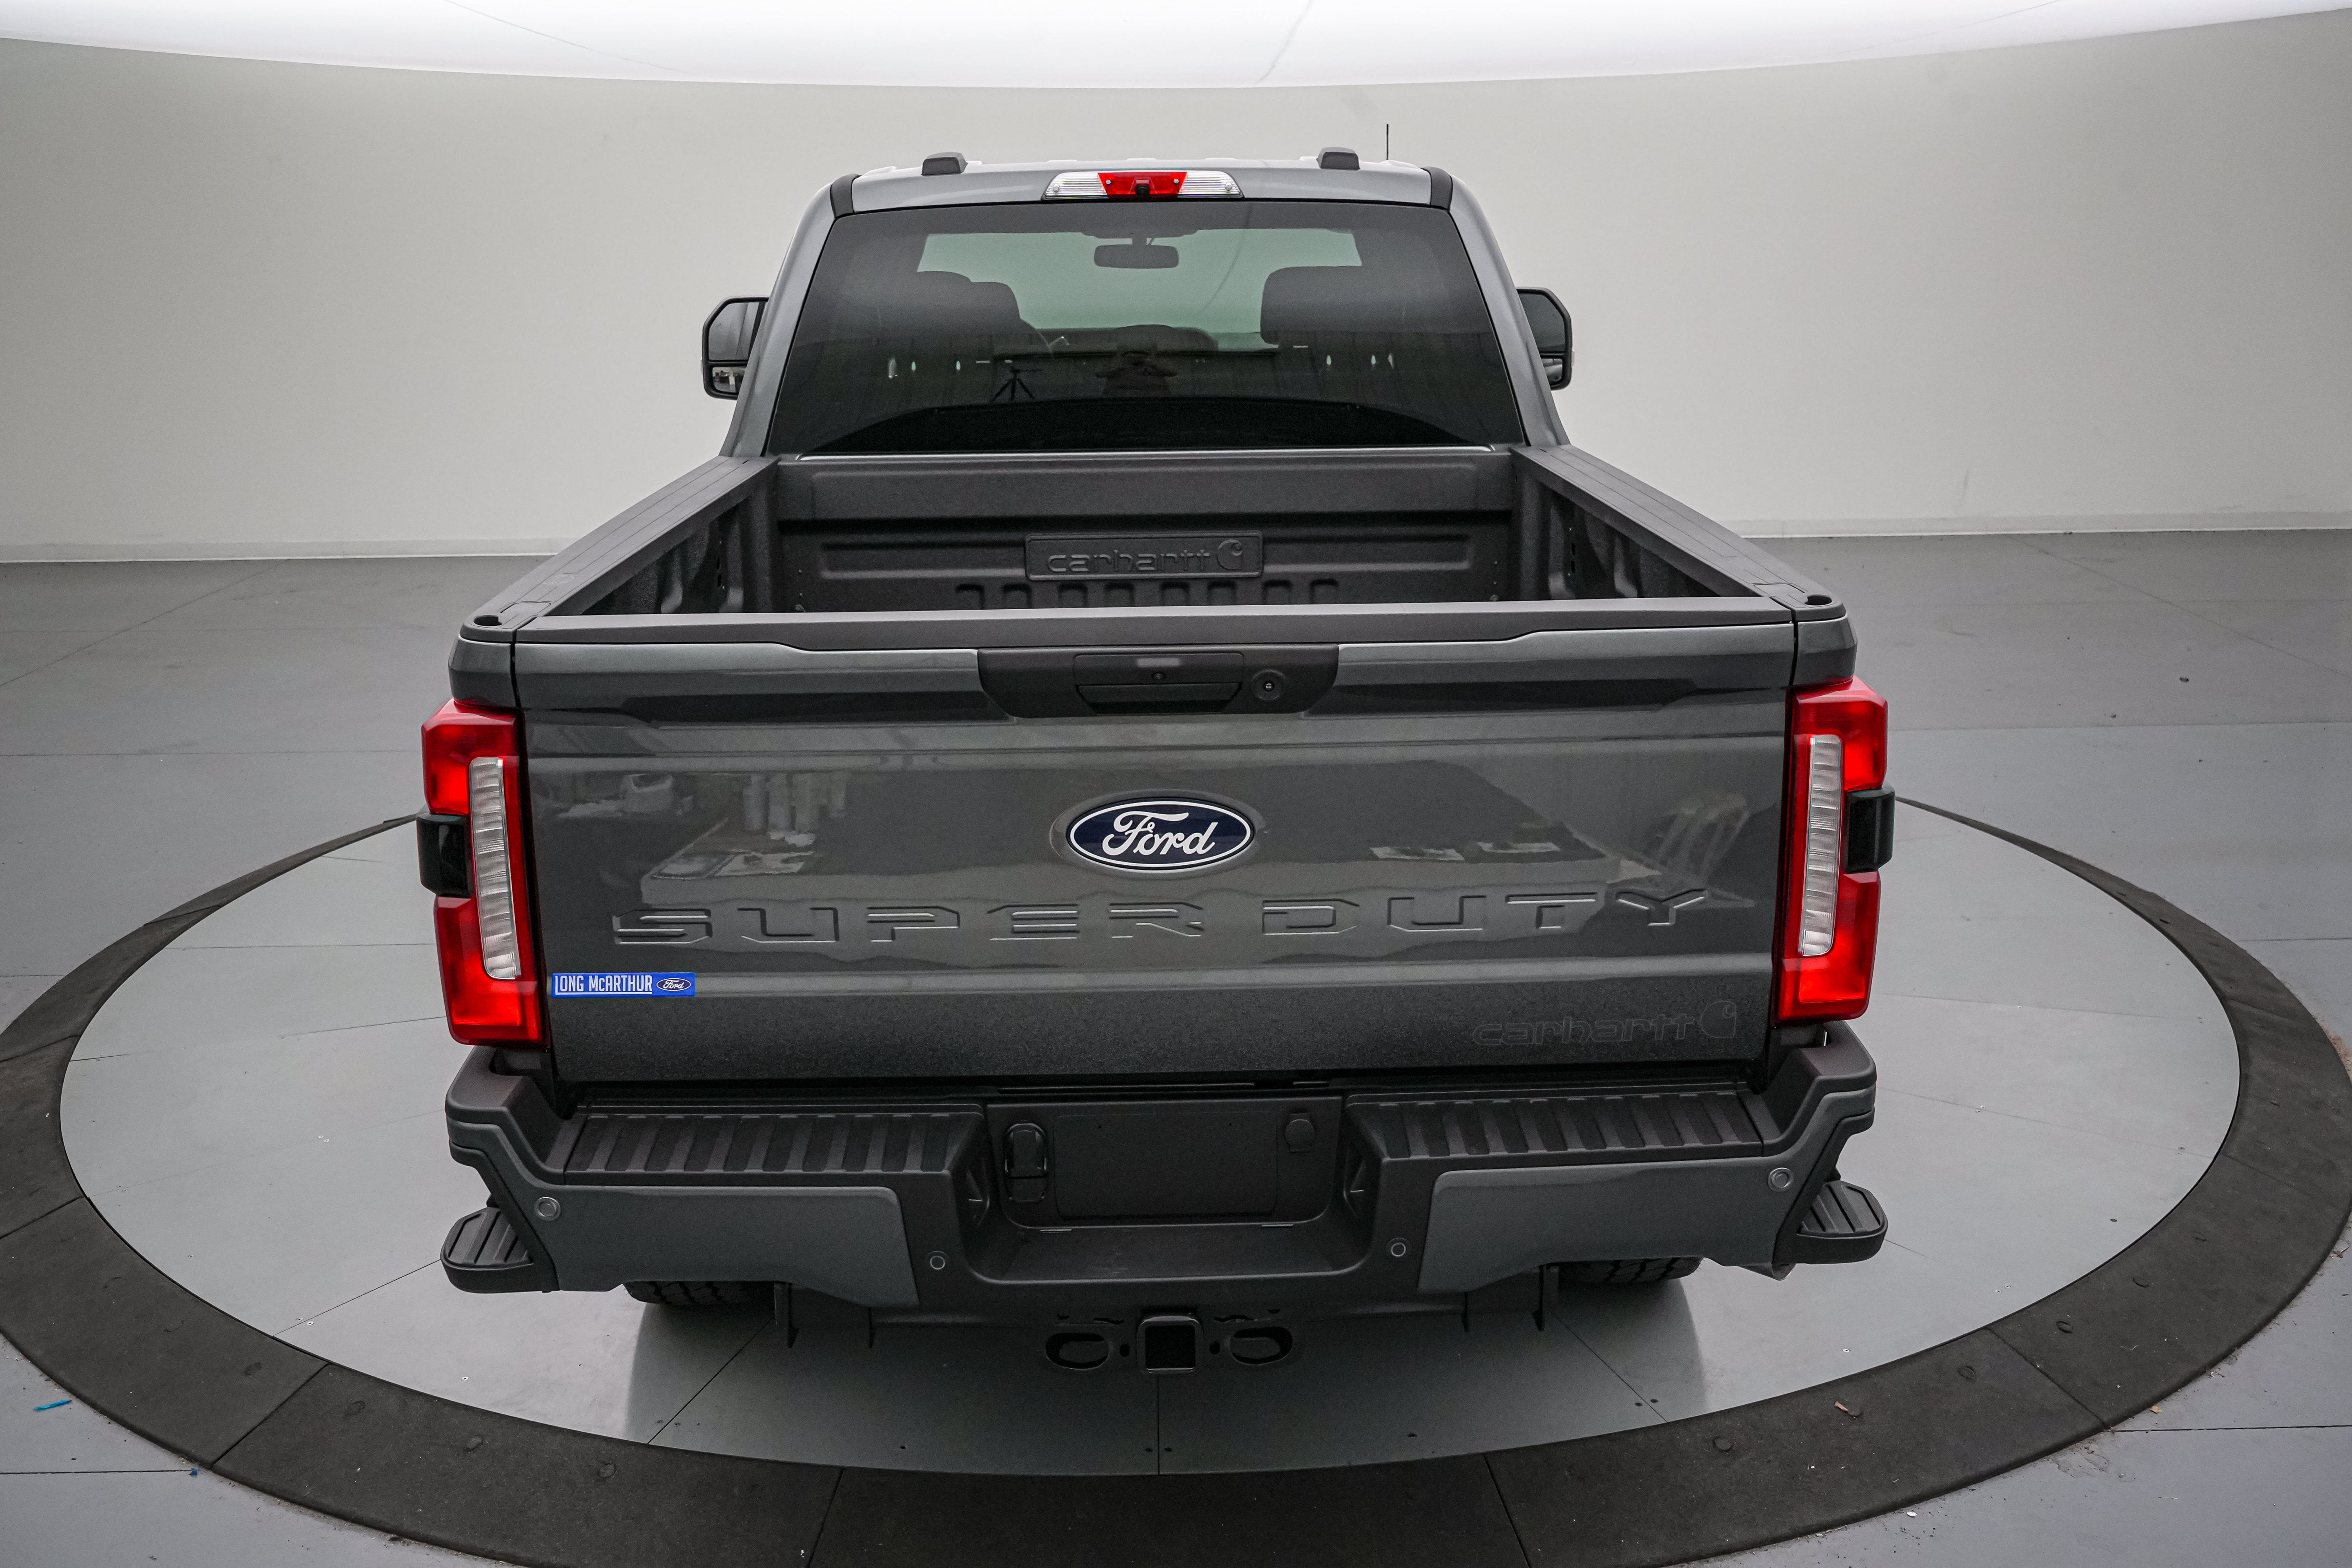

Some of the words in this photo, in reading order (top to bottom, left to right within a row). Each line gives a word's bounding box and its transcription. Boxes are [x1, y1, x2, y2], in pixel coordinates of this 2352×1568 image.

[1046, 549, 1210, 572] carhartt
[1102, 811, 1218, 855] Ford
[612, 901, 1204, 944] SUPER
[1262, 888, 1707, 936] DUTY
[555, 975, 584, 995] LONG
[663, 980, 684, 989] Ford
[1472, 1013, 1695, 1046] carhartt
